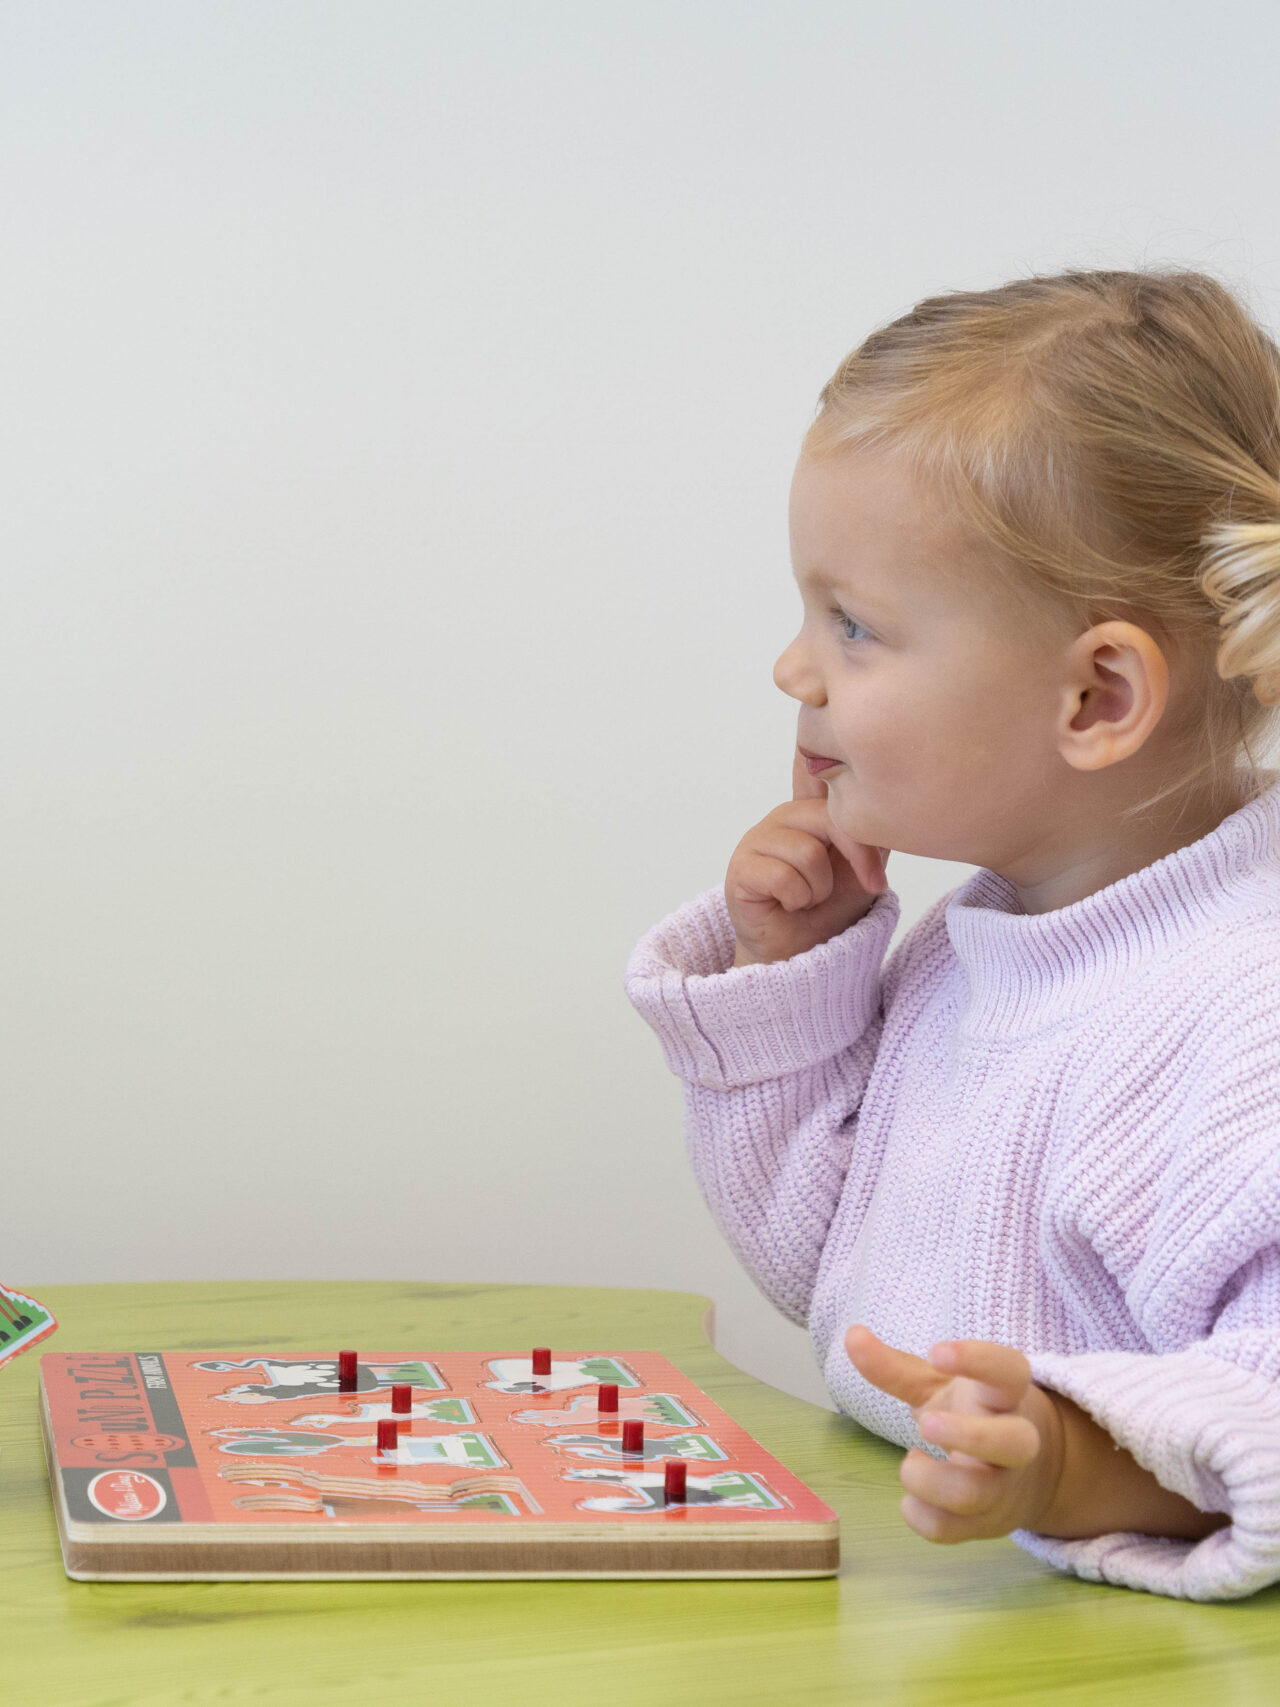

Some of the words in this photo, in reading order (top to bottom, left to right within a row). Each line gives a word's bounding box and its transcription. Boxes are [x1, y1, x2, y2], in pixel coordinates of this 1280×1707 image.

[138, 1355, 164, 1375] ANIMALS
[65, 1355, 140, 1400] PUZZLE
[144, 1375, 168, 1389] FARM
